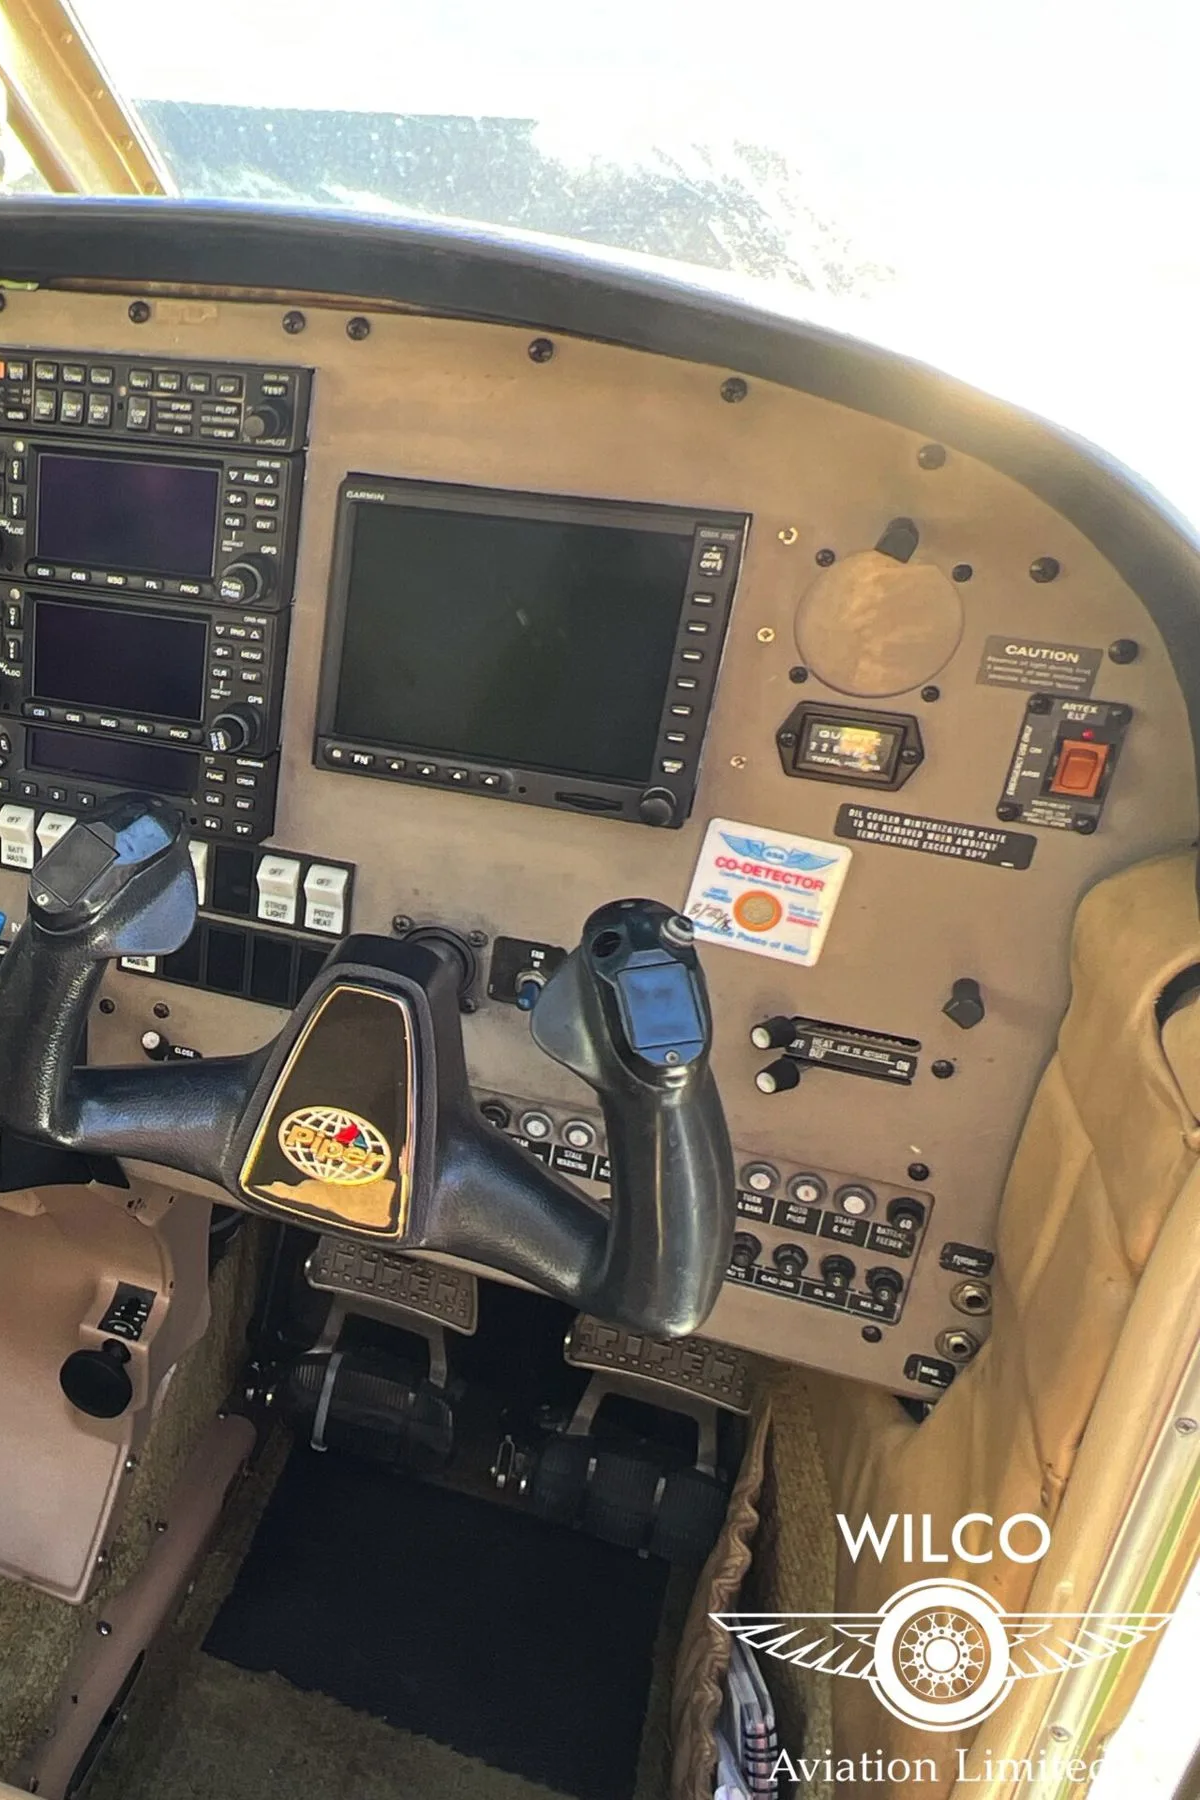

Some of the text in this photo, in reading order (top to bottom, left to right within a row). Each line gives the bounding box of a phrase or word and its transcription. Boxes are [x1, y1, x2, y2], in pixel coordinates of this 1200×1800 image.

[262, 385, 287, 396] TEST
[215, 405, 238, 415] PILOT
[213, 429, 236, 439] CREW
[346, 490, 385, 501] GARMIN
[254, 497, 276, 508] MENU
[225, 517, 240, 527] CLR
[255, 520, 272, 530] ENT
[260, 546, 277, 555] GPS
[221, 581, 241, 592] PUSH
[240, 651, 262, 661] MENU
[1004, 644, 1080, 664] CAUTION
[212, 668, 228, 678] CLR
[242, 672, 257, 682] ENT
[247, 696, 264, 705] GPS
[1061, 702, 1099, 714] ARTEX
[1066, 712, 1087, 721] ELT
[169, 729, 190, 740] PROC
[1029, 746, 1043, 755] ON
[353, 754, 369, 766] FN
[206, 771, 224, 782] FUNC
[53, 791, 60, 800] 3
[82, 797, 89, 805] 4
[6, 815, 21, 824] OFF
[47, 823, 62, 832] OFF
[848, 808, 1008, 844] OIL COOLER WINTERIZATION PLATE
[852, 819, 999, 852] TO BE REMOVED WHEN AMBIENT
[856, 829, 920, 848] TEMPERATURE
[921, 841, 963, 856] EXCEEDS
[269, 867, 284, 877] OFF
[714, 856, 826, 891] CO-DETECTOR
[316, 877, 332, 886] OFF
[264, 900, 288, 912] STROB
[265, 909, 287, 920] LIGHT
[312, 917, 332, 928] HEAT
[736, 931, 810, 956] Peace of Mind
[811, 1037, 836, 1049] HEAT
[174, 1046, 195, 1058] CLOSE
[896, 1060, 910, 1072] ON
[284, 1124, 386, 1169] Piper
[563, 1149, 583, 1162] STALL
[556, 1157, 588, 1172] WARNING
[743, 1193, 762, 1204] TURN
[737, 1201, 765, 1215] & BANK
[788, 1204, 809, 1216] AUTO
[785, 1213, 808, 1225] PILOT
[833, 1215, 857, 1227] START
[899, 1219, 913, 1230] 60
[832, 1225, 855, 1238] & ACC
[875, 1236, 904, 1250] FEEDER
[784, 1265, 793, 1276] 5
[833, 1276, 841, 1287] 3
[881, 1290, 889, 1301] 3
